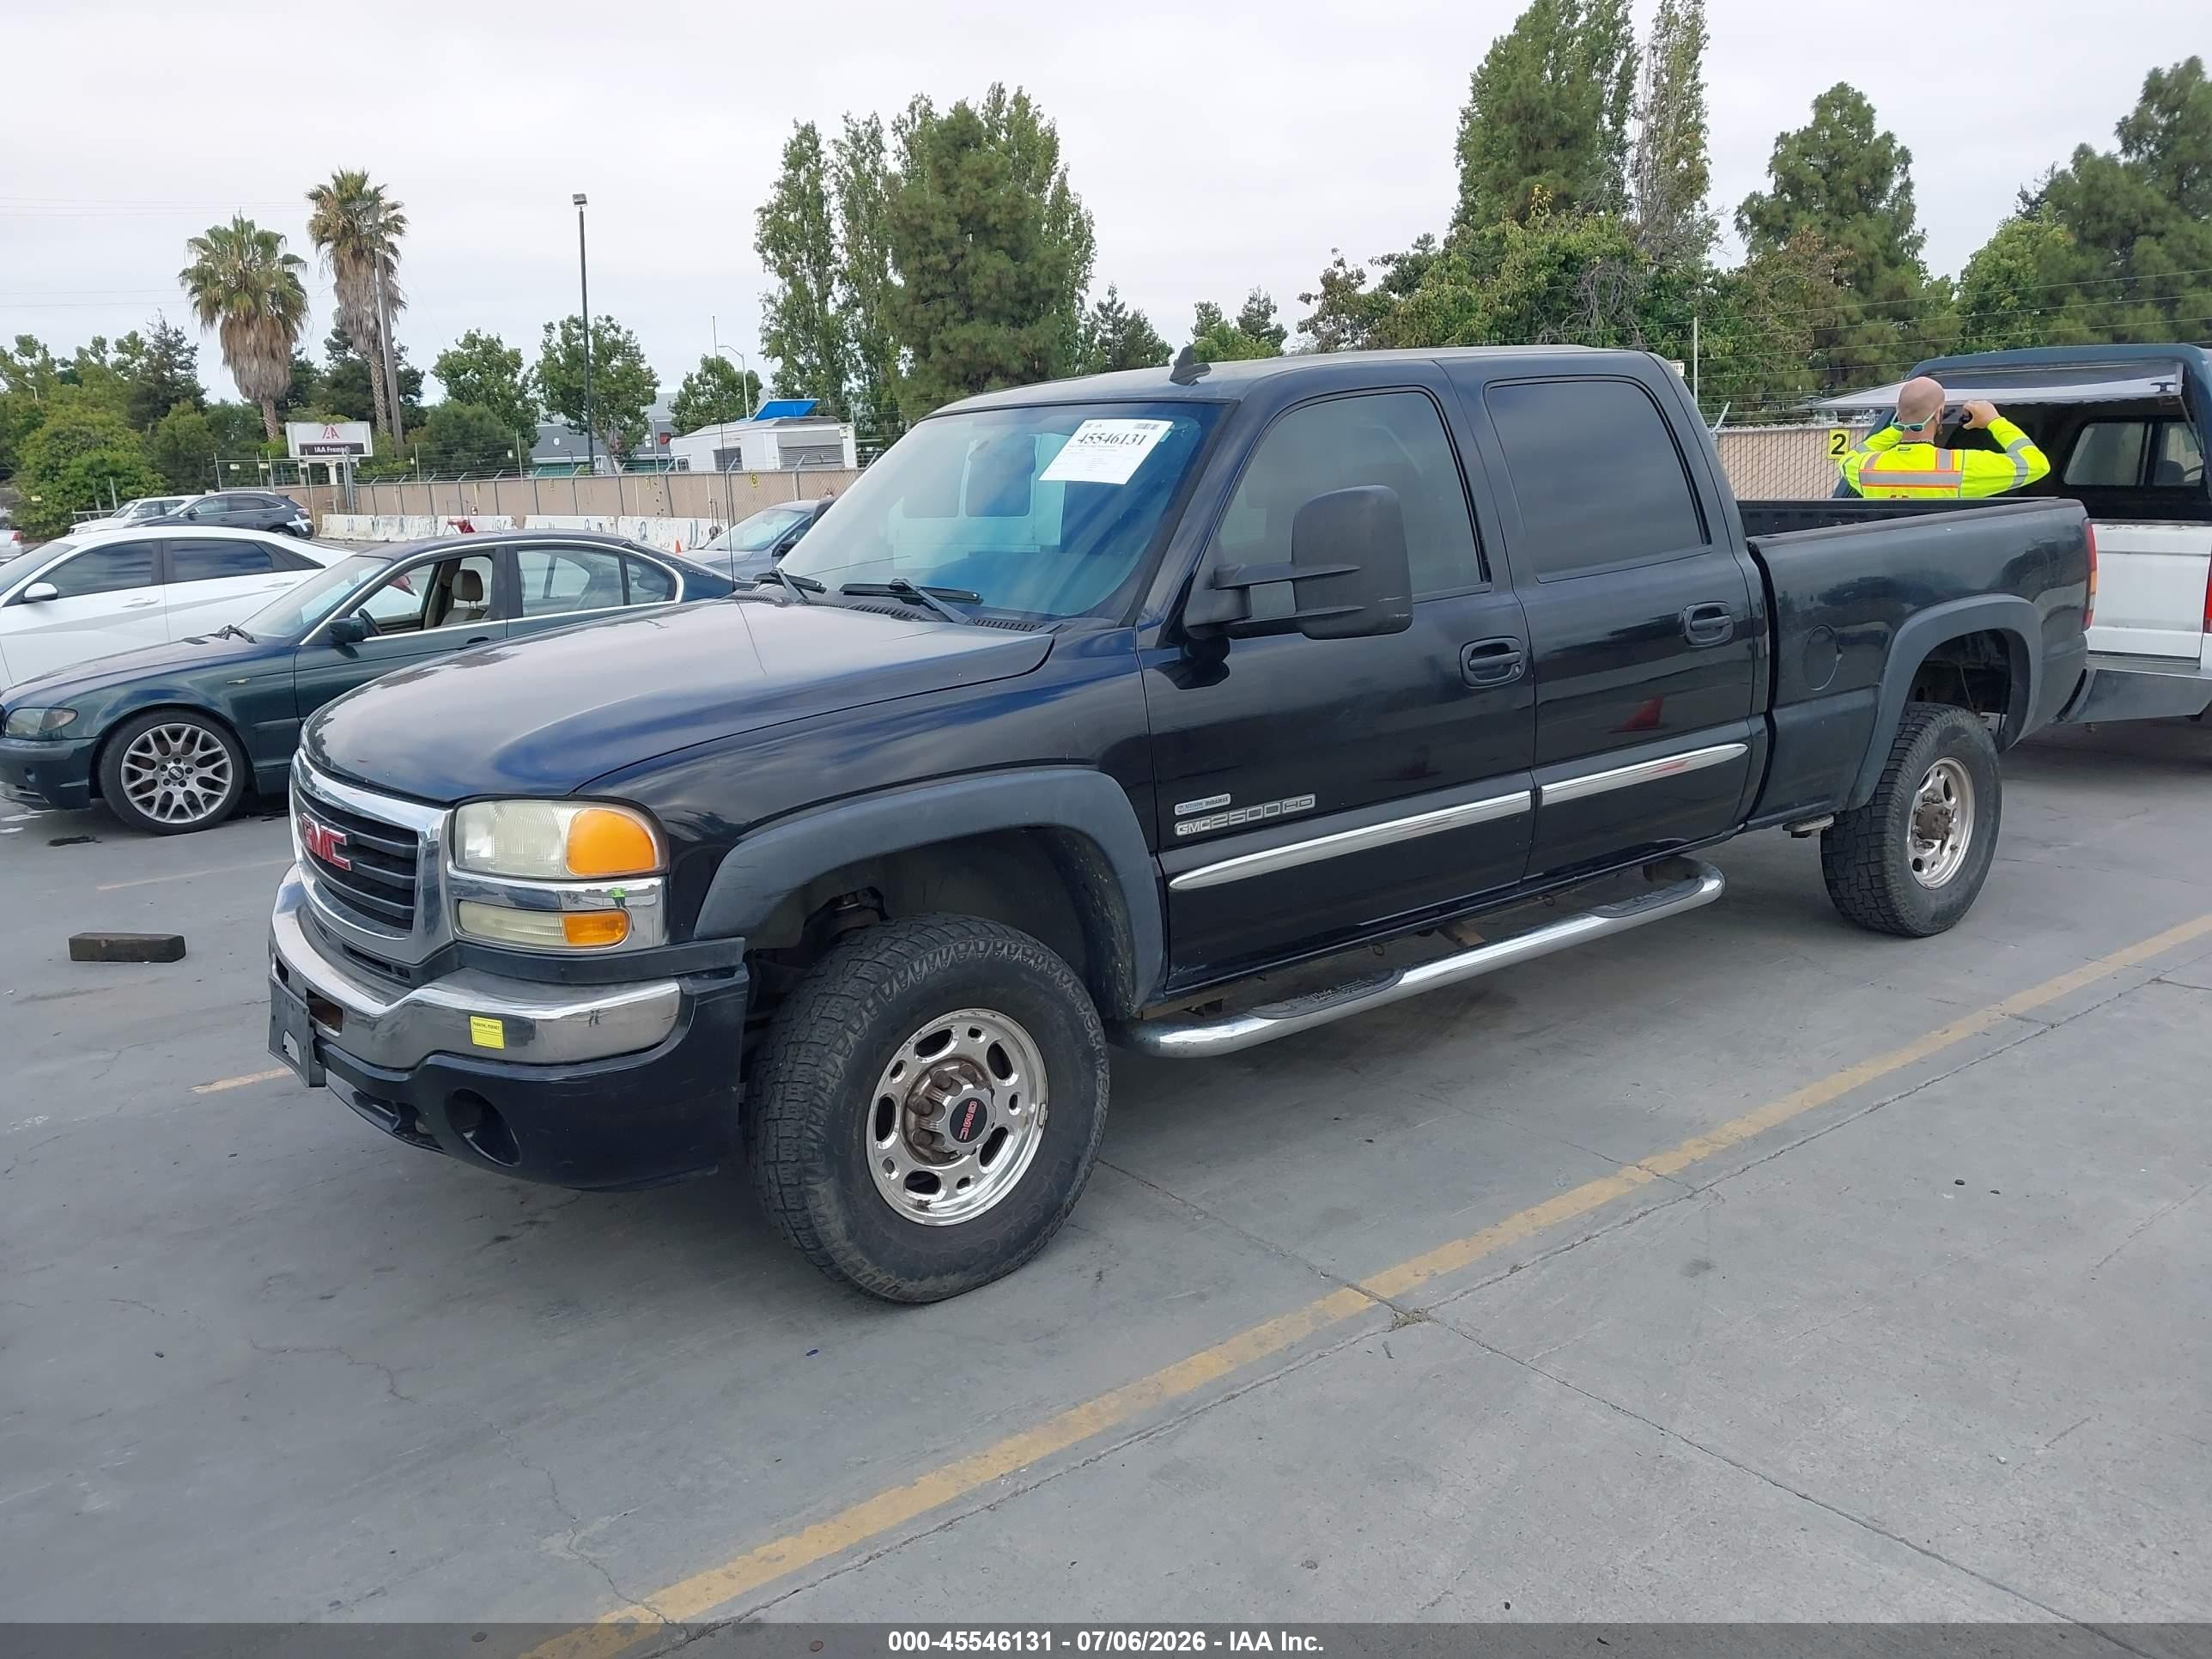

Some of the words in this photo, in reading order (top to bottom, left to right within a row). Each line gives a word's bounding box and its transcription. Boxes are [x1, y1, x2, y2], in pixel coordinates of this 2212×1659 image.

[1078, 432, 1147, 446] 45546131
[1831, 433, 1847, 455] 2
[958, 1100, 978, 1140] GMC
